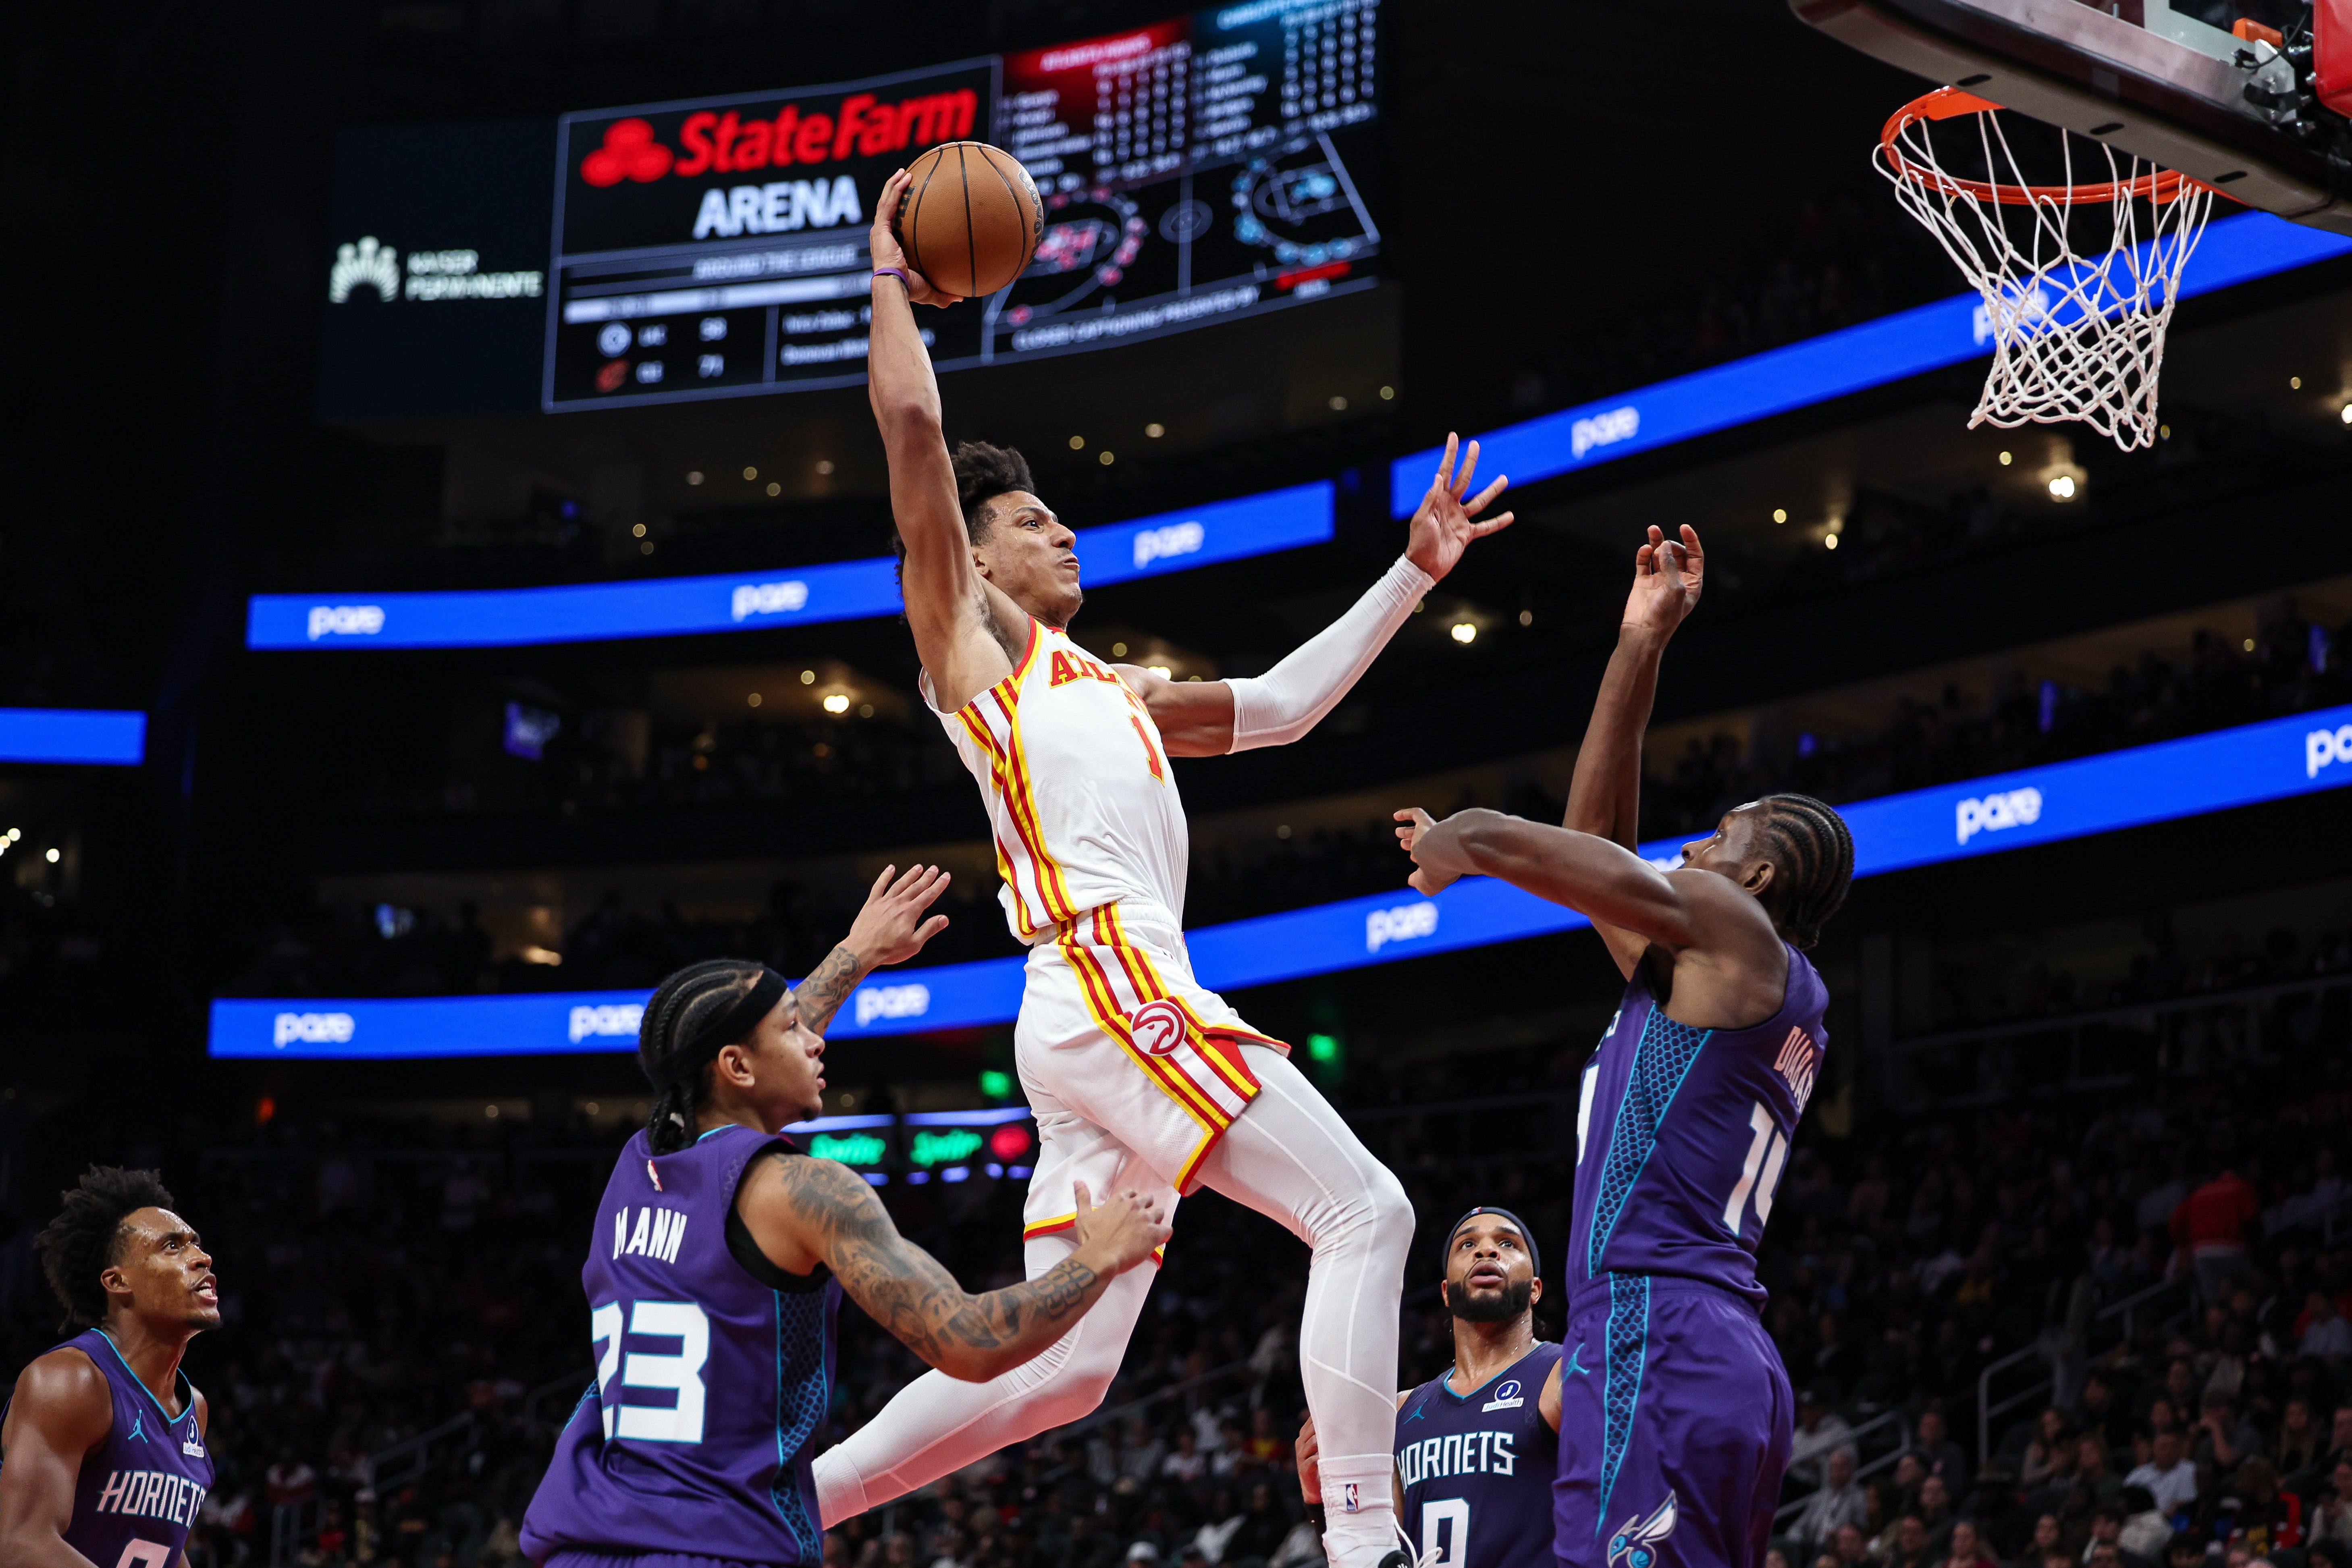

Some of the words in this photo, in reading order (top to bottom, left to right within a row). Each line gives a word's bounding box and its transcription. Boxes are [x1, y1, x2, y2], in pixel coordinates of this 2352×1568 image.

[692, 175, 862, 240] ARENA
[1973, 288, 2050, 346] pe
[1572, 406, 1639, 458] paze
[1133, 521, 1205, 569] paze
[308, 605, 385, 640] paze
[731, 581, 808, 621] paze
[1129, 712, 1165, 787] 1
[1956, 787, 2042, 845] paze
[1366, 901, 1439, 953] paze
[274, 1012, 355, 1049] paze
[855, 983, 930, 1027] paze
[613, 1207, 687, 1264] MANN
[592, 1299, 711, 1444] 23
[1396, 1431, 1520, 1495] HORNETS
[1422, 1496, 1470, 1568] 0
